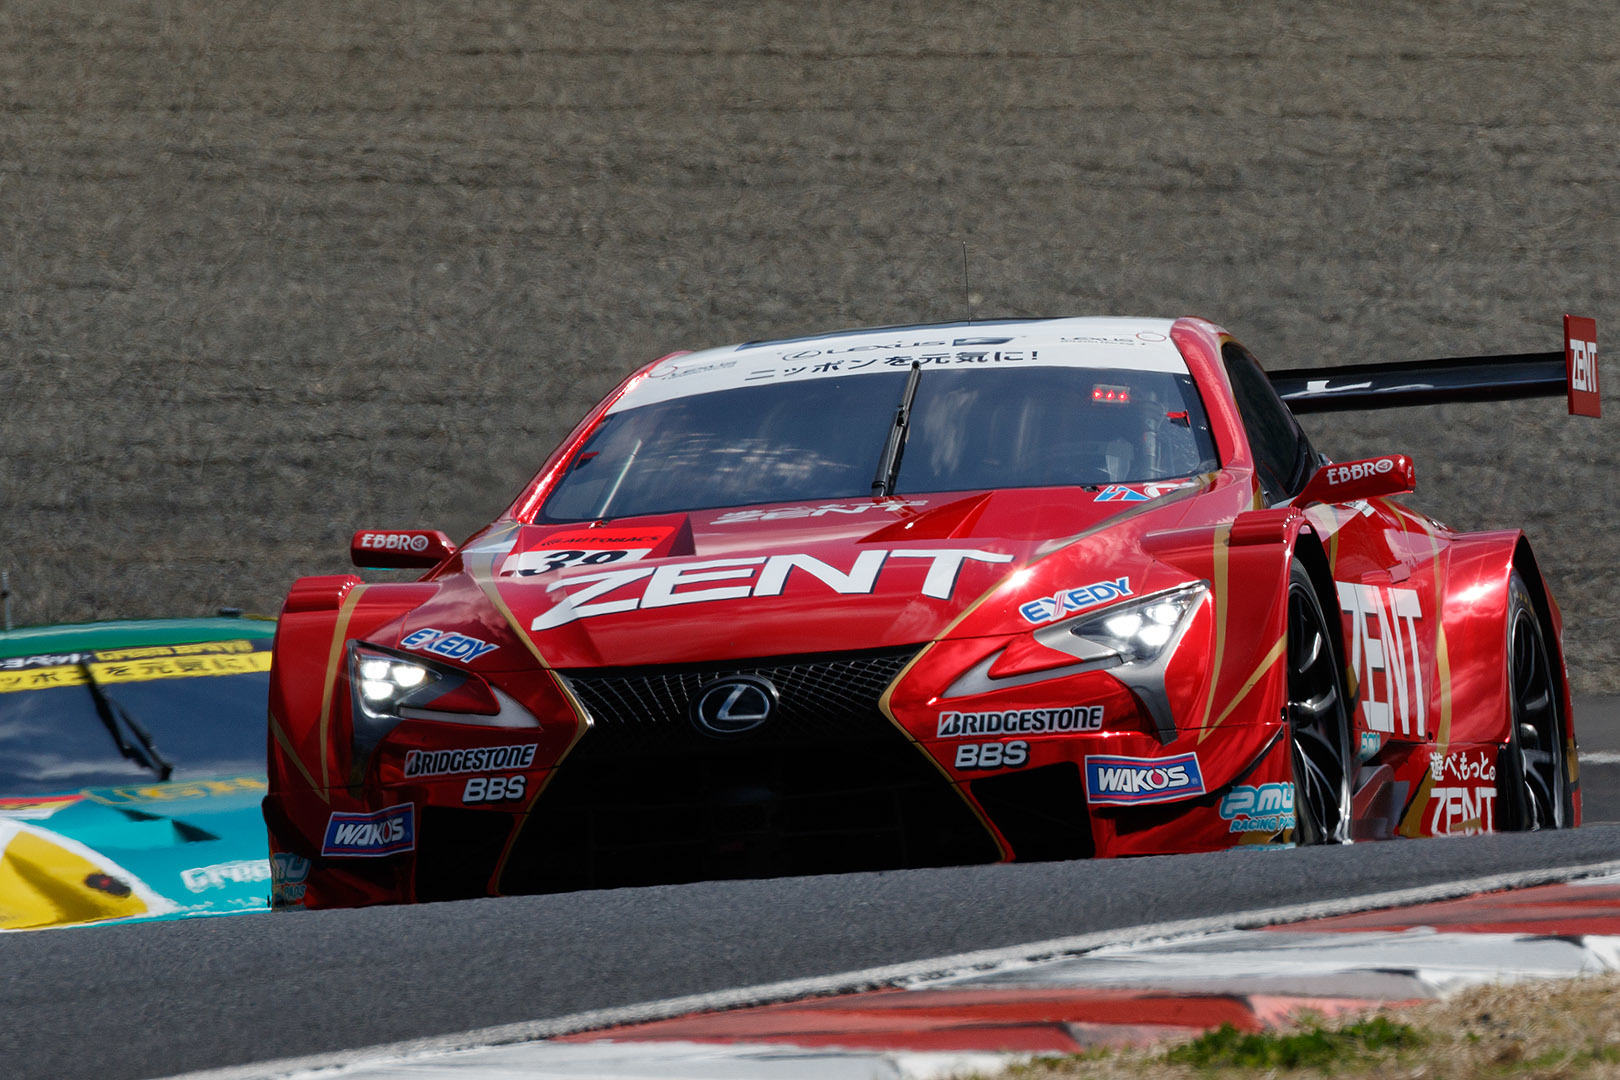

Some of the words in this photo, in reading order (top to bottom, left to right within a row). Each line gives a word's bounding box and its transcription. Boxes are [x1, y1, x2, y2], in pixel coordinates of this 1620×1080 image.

[1569, 338, 1598, 393] ZENT
[1326, 459, 1394, 486] EBBRO
[361, 533, 429, 551] EBBRO
[531, 549, 1014, 631] ZENT
[1019, 576, 1133, 623] EXEDY
[400, 628, 500, 663] EXEDY
[1335, 581, 1425, 737] ZENT
[937, 706, 1104, 737] BRIDGESTONE
[404, 743, 538, 777] BRIDGESTONE
[954, 740, 1030, 770] BBS
[462, 775, 527, 804] BBS
[1229, 816, 1277, 833] RACING
[1430, 787, 1497, 838] ZENT
